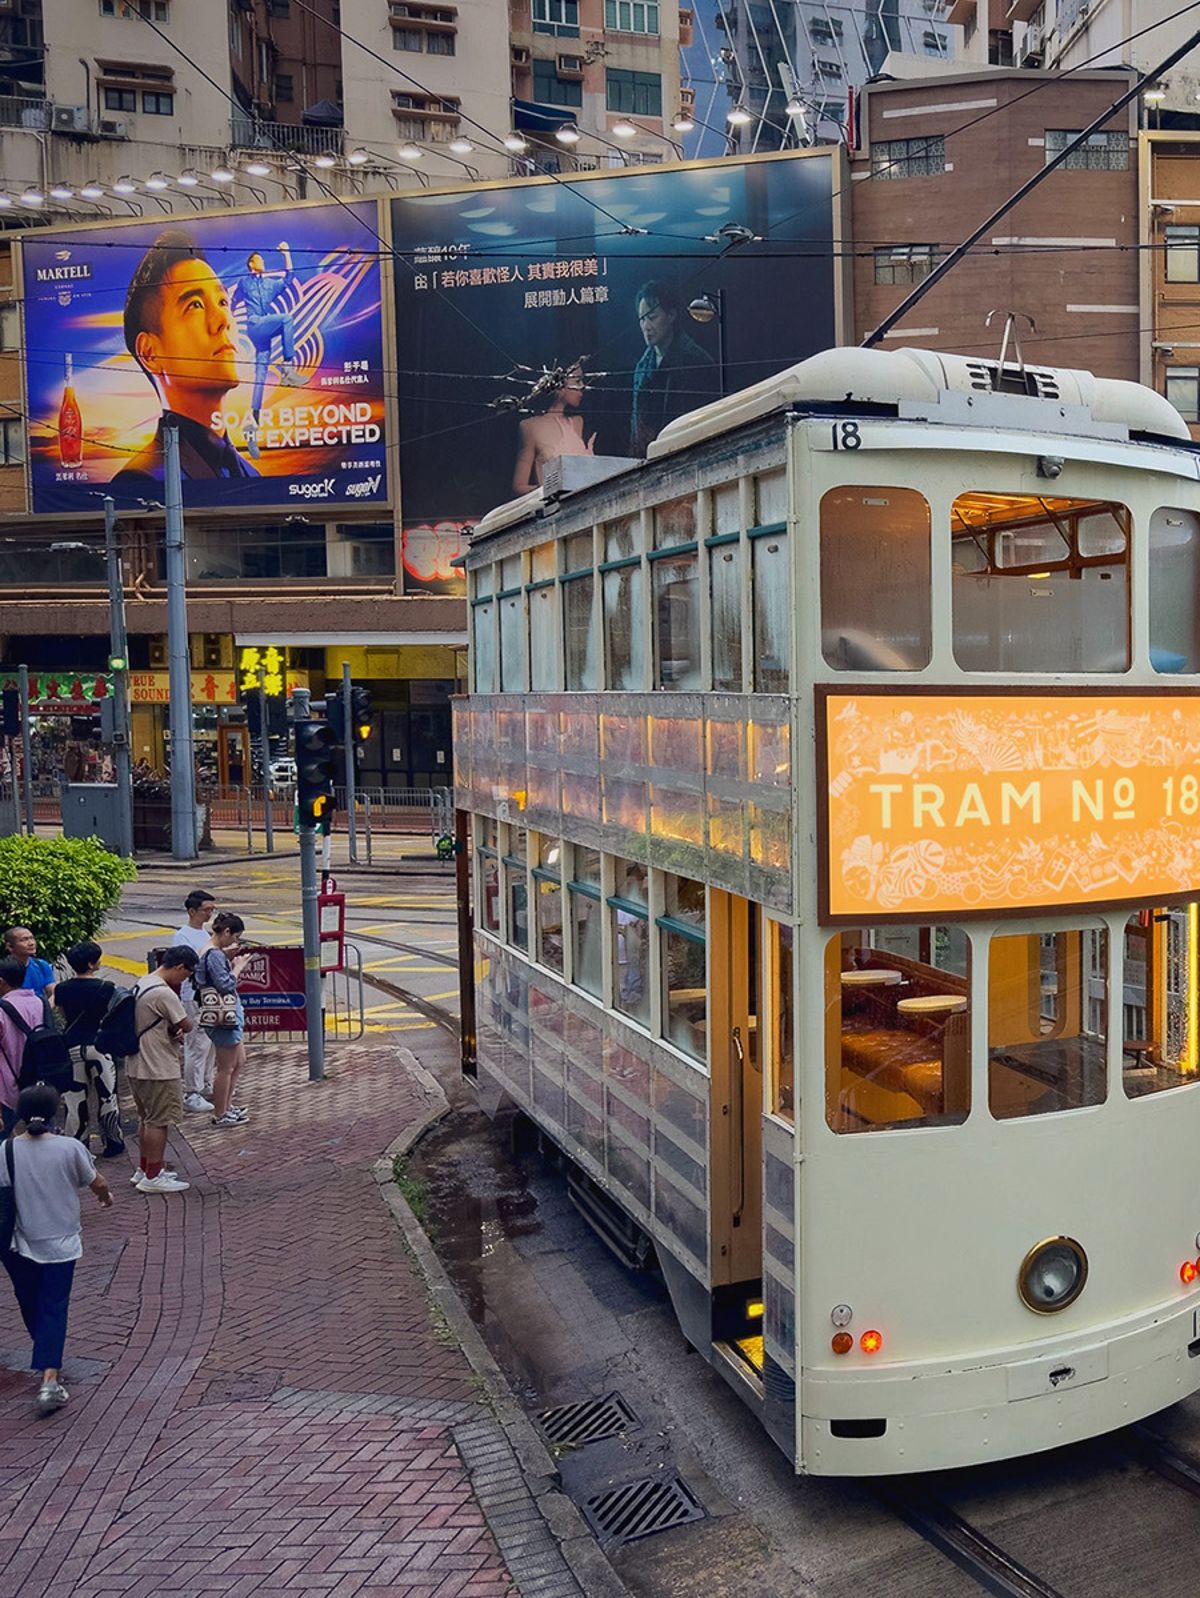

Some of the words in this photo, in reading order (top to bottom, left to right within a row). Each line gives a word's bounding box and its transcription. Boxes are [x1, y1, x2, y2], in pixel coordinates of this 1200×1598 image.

[37, 265, 91, 281] MARTELL
[524, 285, 609, 309] 展開動人篇章
[210, 408, 273, 431] SOAR
[280, 402, 372, 427] BEYOND
[243, 430, 262, 442] THE
[267, 423, 381, 449] EXPECTED
[832, 421, 862, 450] 18
[130, 675, 156, 687] RUE
[869, 781, 1042, 830] TRAM
[1162, 773, 1199, 817] 18
